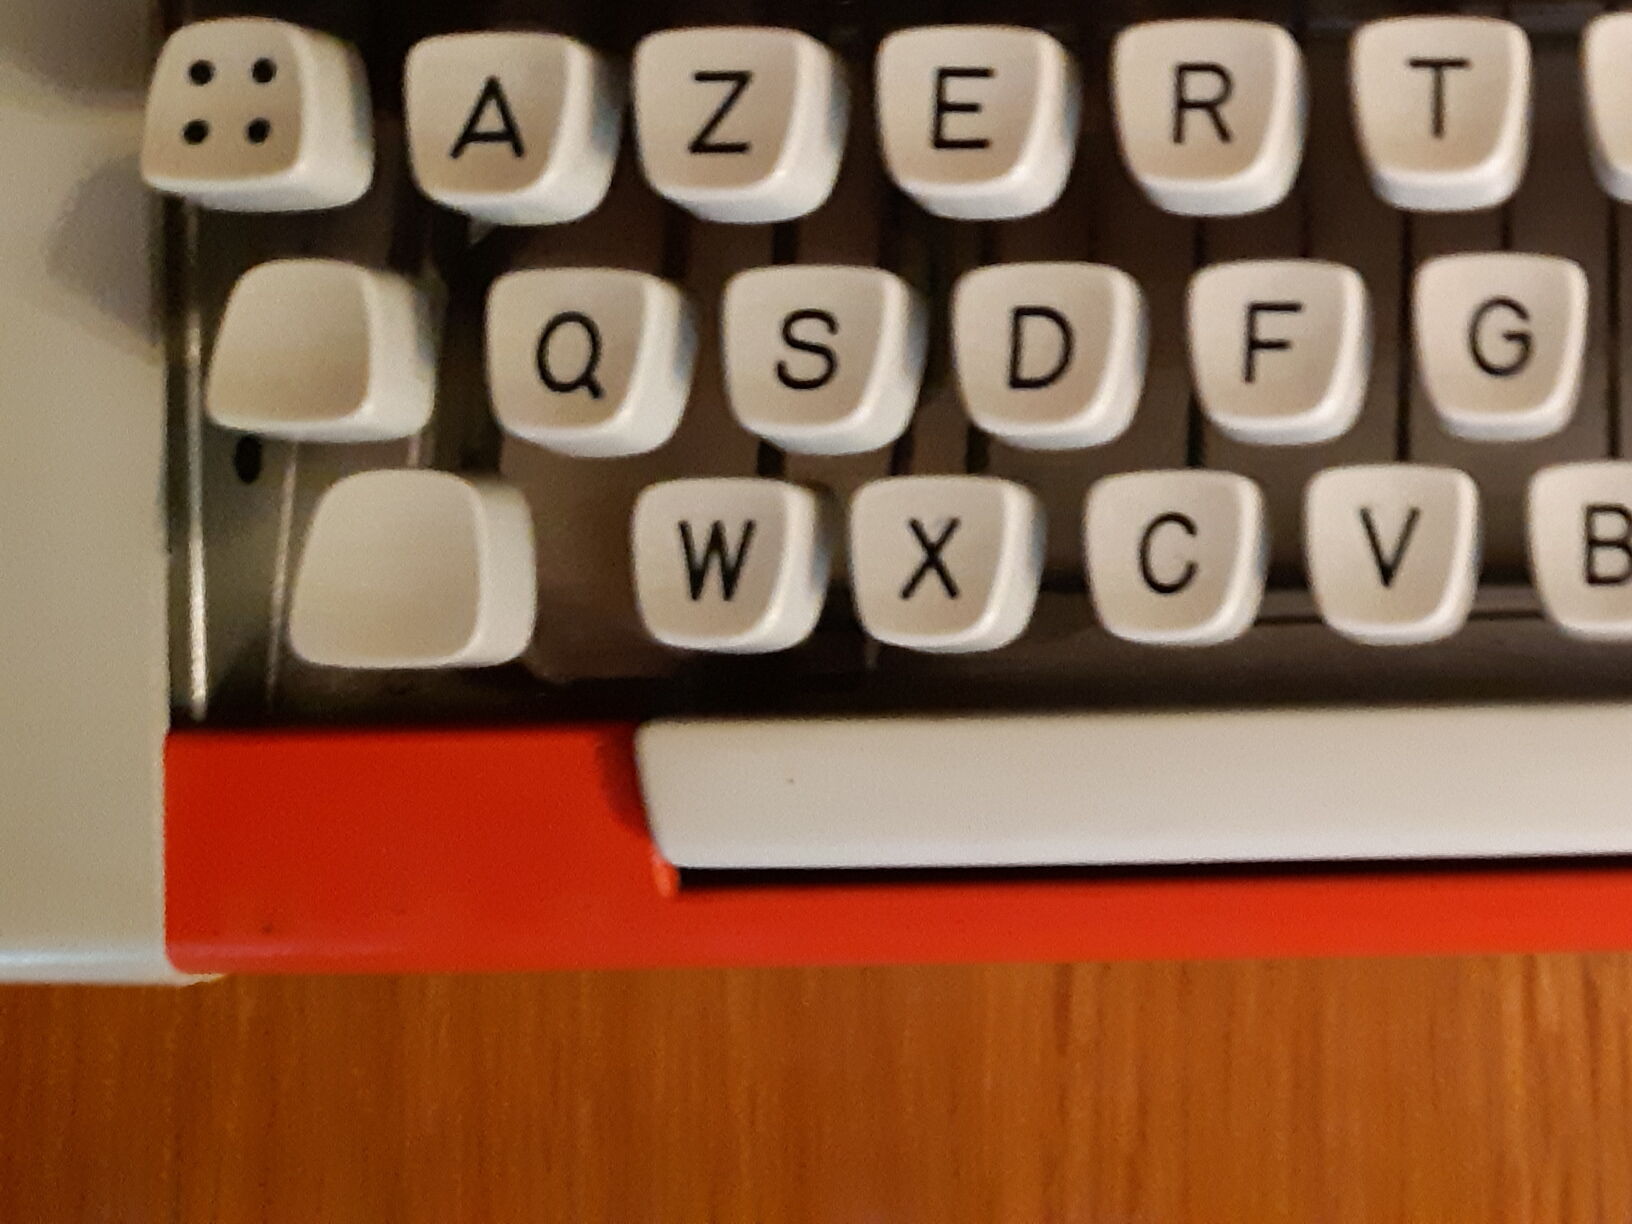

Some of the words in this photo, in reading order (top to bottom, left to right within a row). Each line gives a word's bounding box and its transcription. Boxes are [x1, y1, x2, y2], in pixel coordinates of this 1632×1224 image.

[449, 76, 528, 161] A
[687, 70, 753, 156] Z
[930, 66, 995, 151] E
[1172, 62, 1234, 145] R
[1408, 57, 1471, 139] T
[535, 311, 606, 401] Q
[775, 308, 839, 392] S
[1007, 305, 1075, 391] D
[1243, 301, 1303, 384] F
[1468, 297, 1534, 379] G
[679, 514, 757, 602] W
[900, 517, 961, 601] X
[1138, 511, 1199, 596] C
[1360, 507, 1421, 589] V
